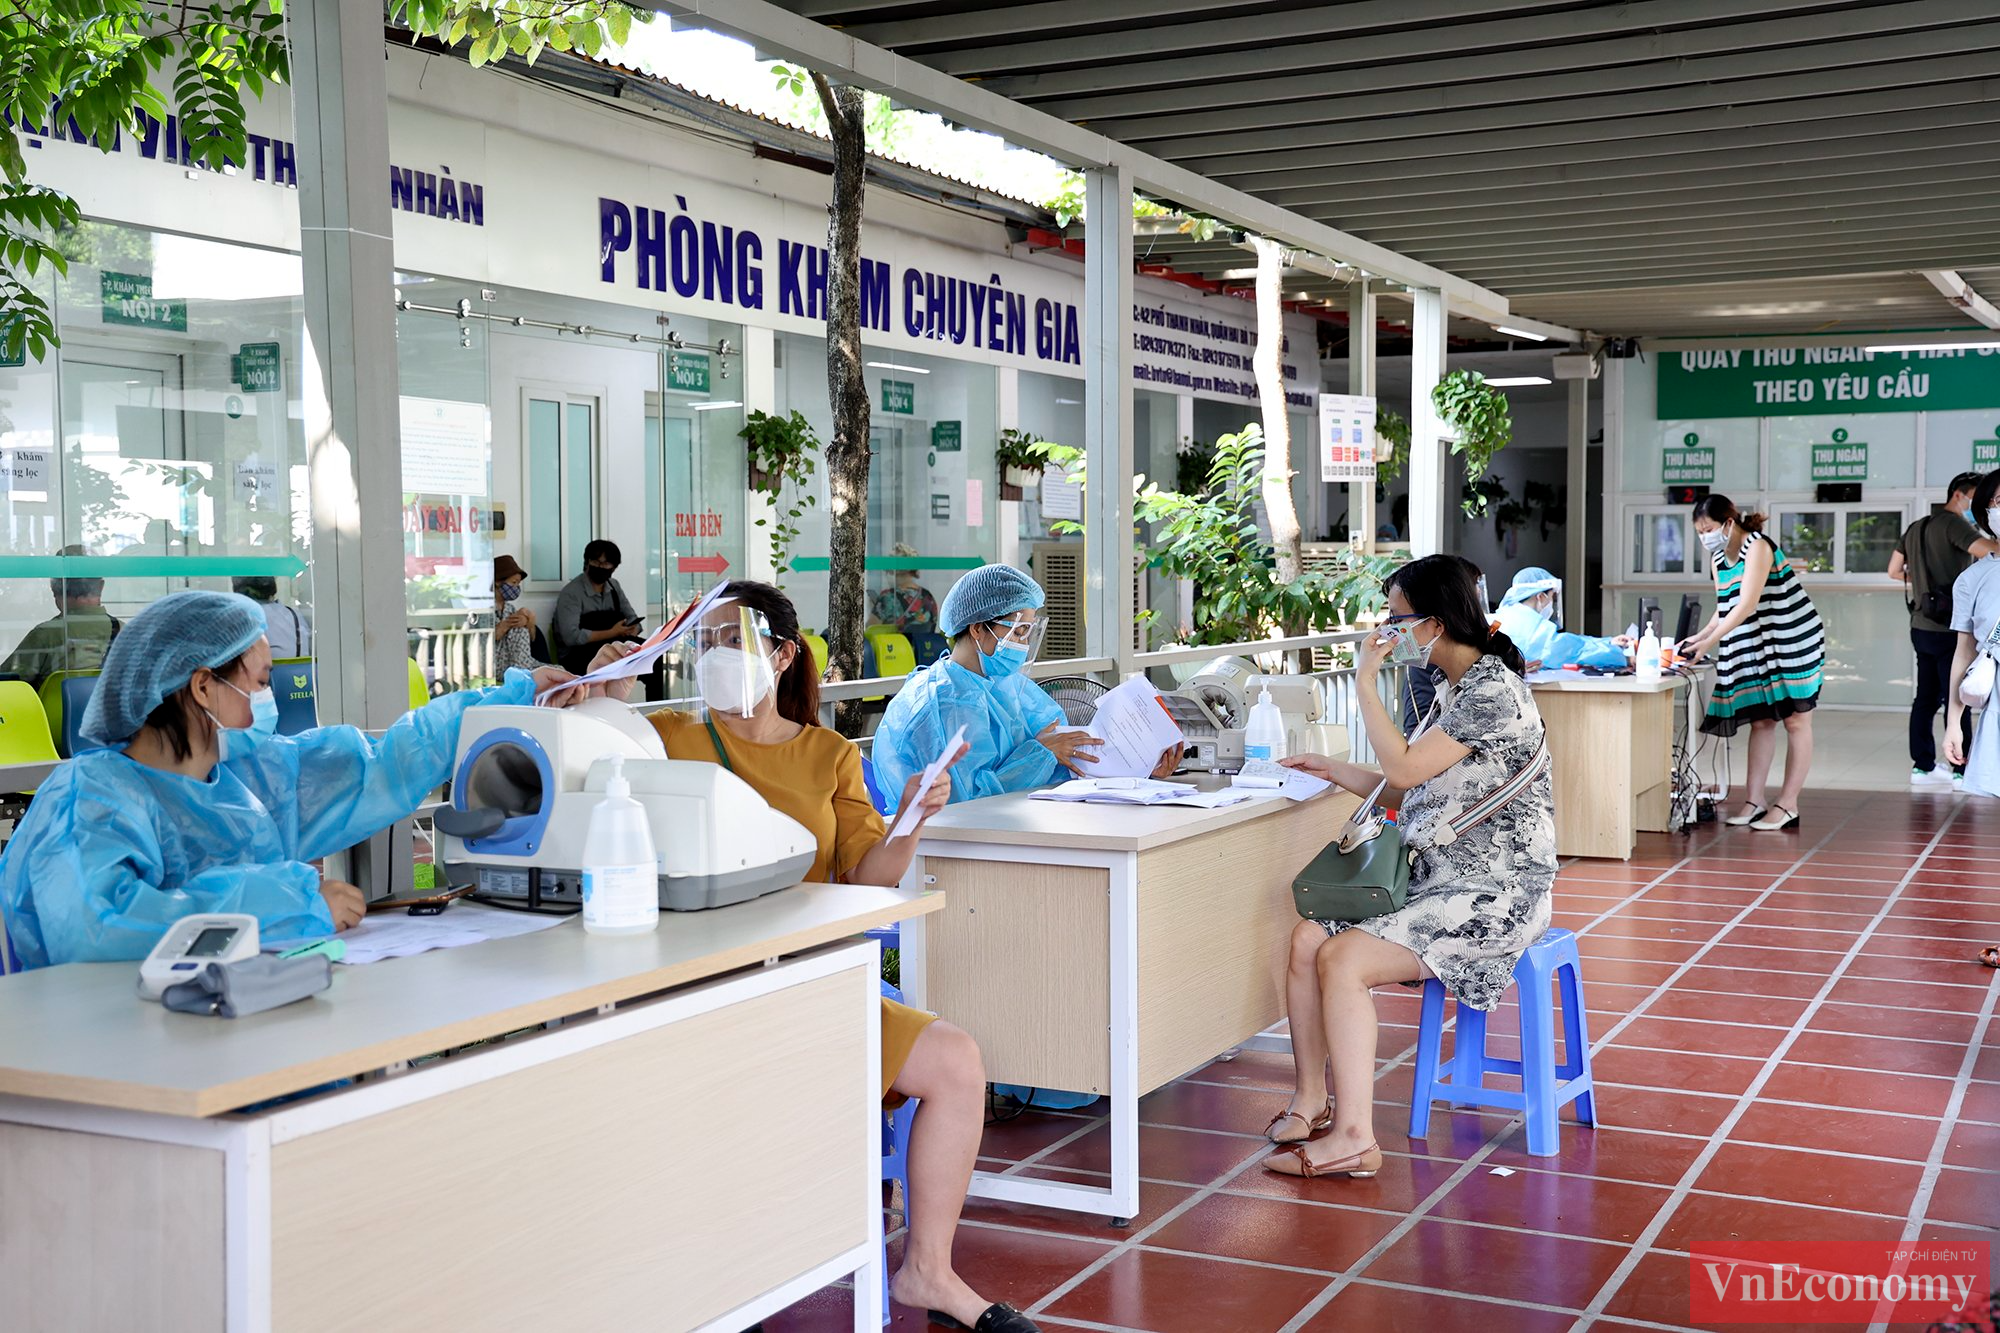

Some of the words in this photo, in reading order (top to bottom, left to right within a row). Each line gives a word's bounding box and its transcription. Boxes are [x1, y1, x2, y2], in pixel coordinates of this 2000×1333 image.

[390, 164, 484, 227] NHÀN
[113, 278, 134, 294] KHÁM
[598, 194, 763, 310] PHÒNG
[778, 238, 890, 333] KHM
[903, 268, 1025, 356] CHUYÊN
[1035, 297, 1081, 366] GIA
[122, 296, 156, 323] NỘI
[161, 304, 172, 322] 2
[247, 368, 267, 388] NỘI
[269, 370, 276, 385] 2
[676, 369, 695, 387] NỘI
[696, 373, 703, 386] 3
[1752, 378, 1815, 403] THEO
[1821, 372, 1870, 401] YÊU
[1877, 366, 1930, 399] CẦU
[902, 397, 908, 409] 4
[17, 451, 44, 461] khám
[1665, 453, 1684, 466] THU
[1685, 450, 1713, 466] NGÂN
[1814, 449, 1834, 463] THU
[1836, 445, 1866, 463] NGÂN
[1975, 445, 1997, 459] THU
[25, 467, 39, 479] lọc
[1813, 464, 1836, 477] KHÁM
[1837, 465, 1866, 477] ONLINE
[675, 513, 697, 537] HAI
[699, 507, 722, 537] BÊN
[289, 691, 314, 700] STELLA
